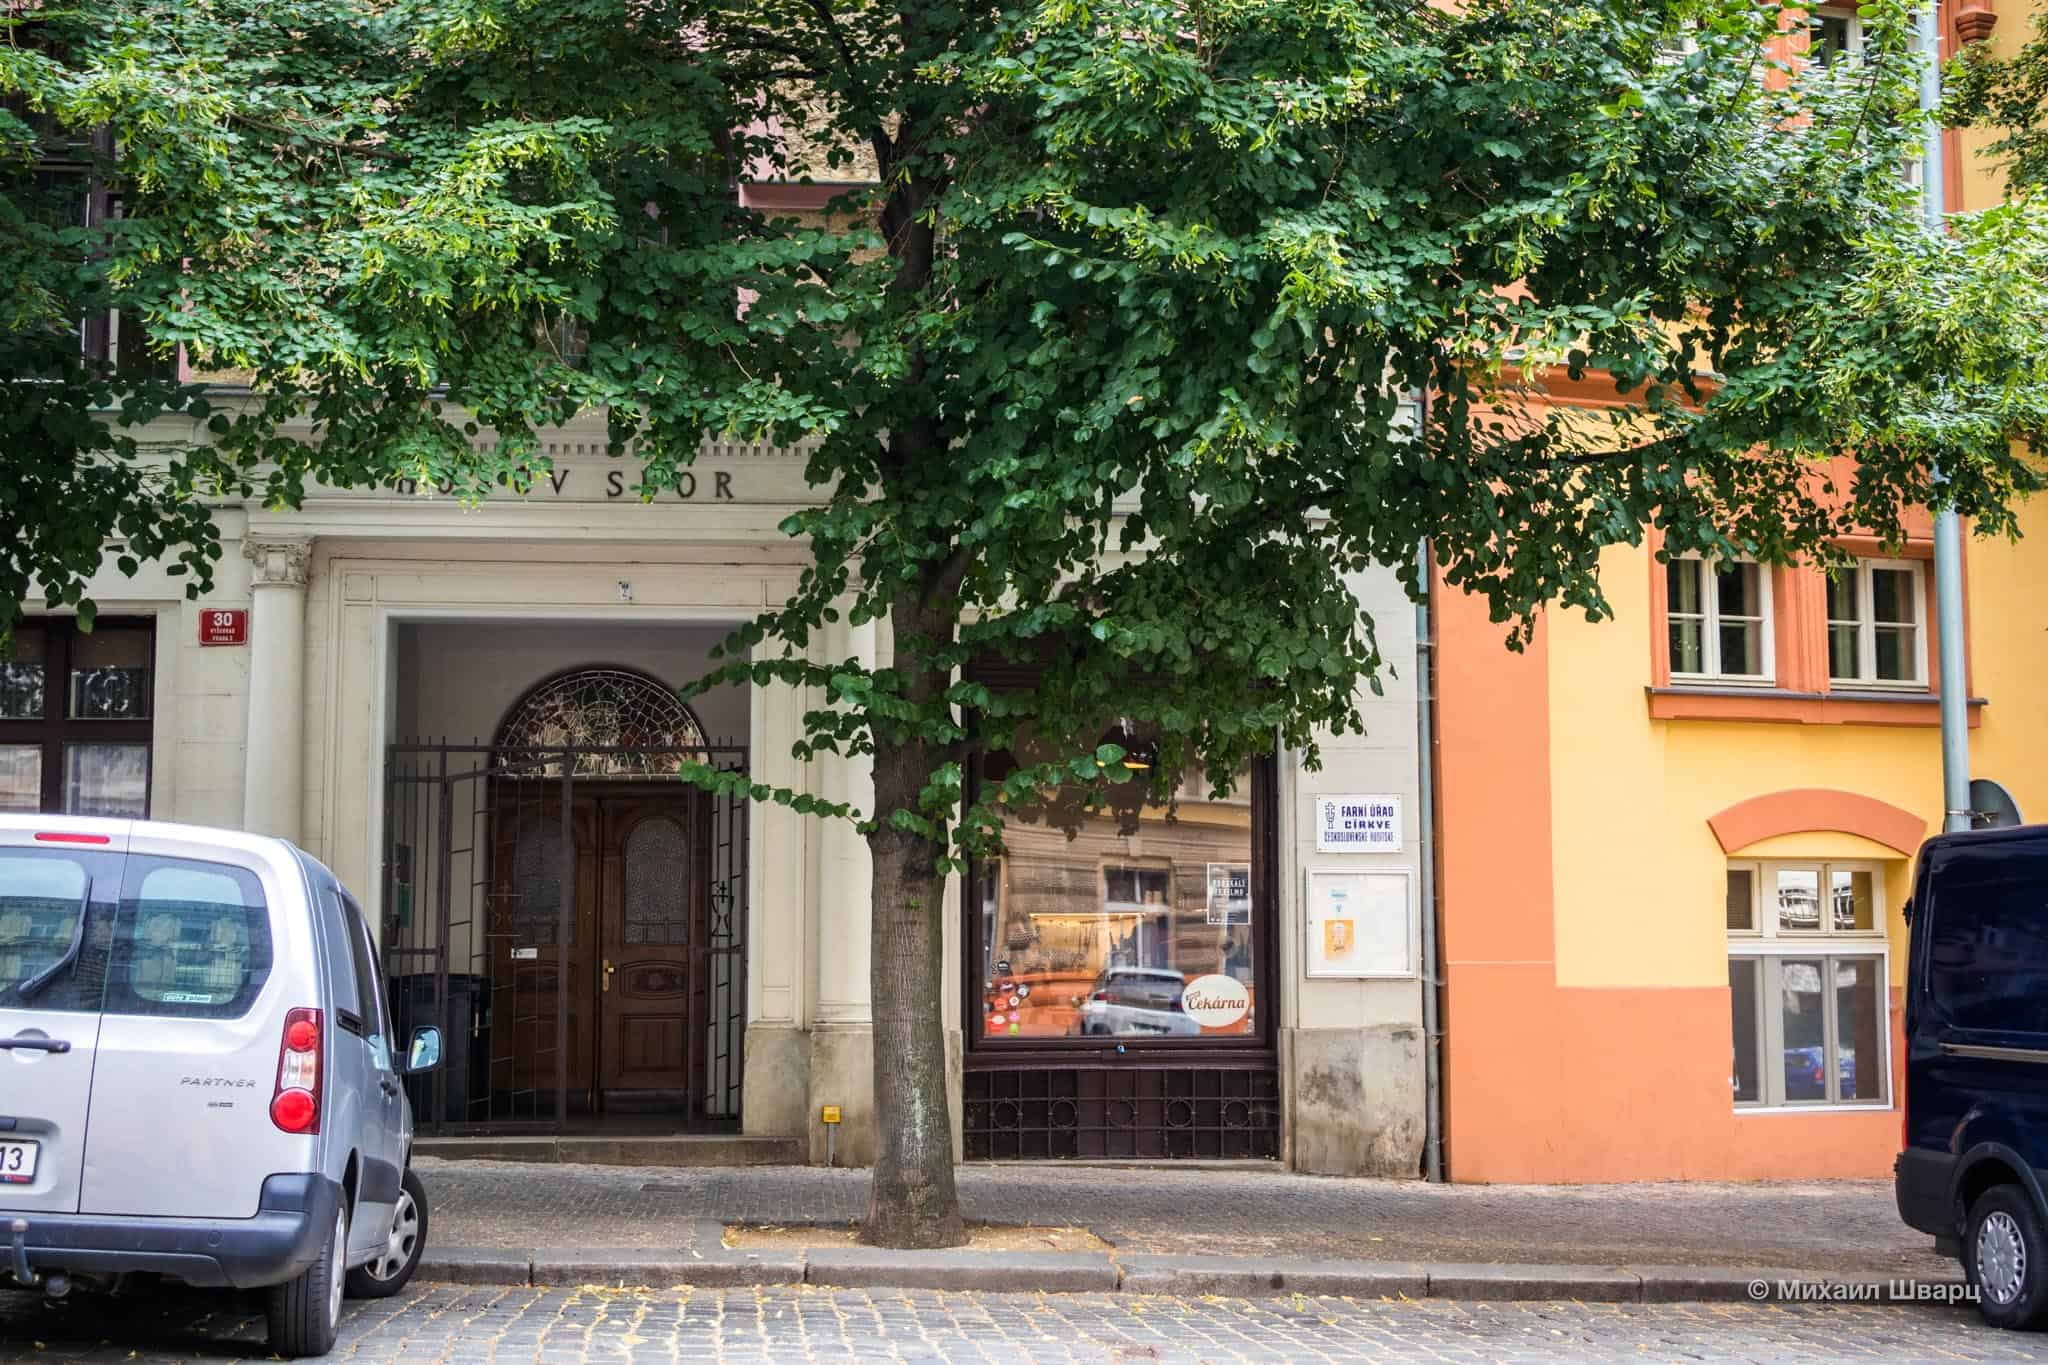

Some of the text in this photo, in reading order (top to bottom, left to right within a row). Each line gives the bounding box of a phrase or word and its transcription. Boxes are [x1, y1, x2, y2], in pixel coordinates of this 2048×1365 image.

[213, 612, 233, 626] 30
[1344, 818, 1391, 829] CÍRKVE
[180, 1076, 256, 1088] PARTNER
